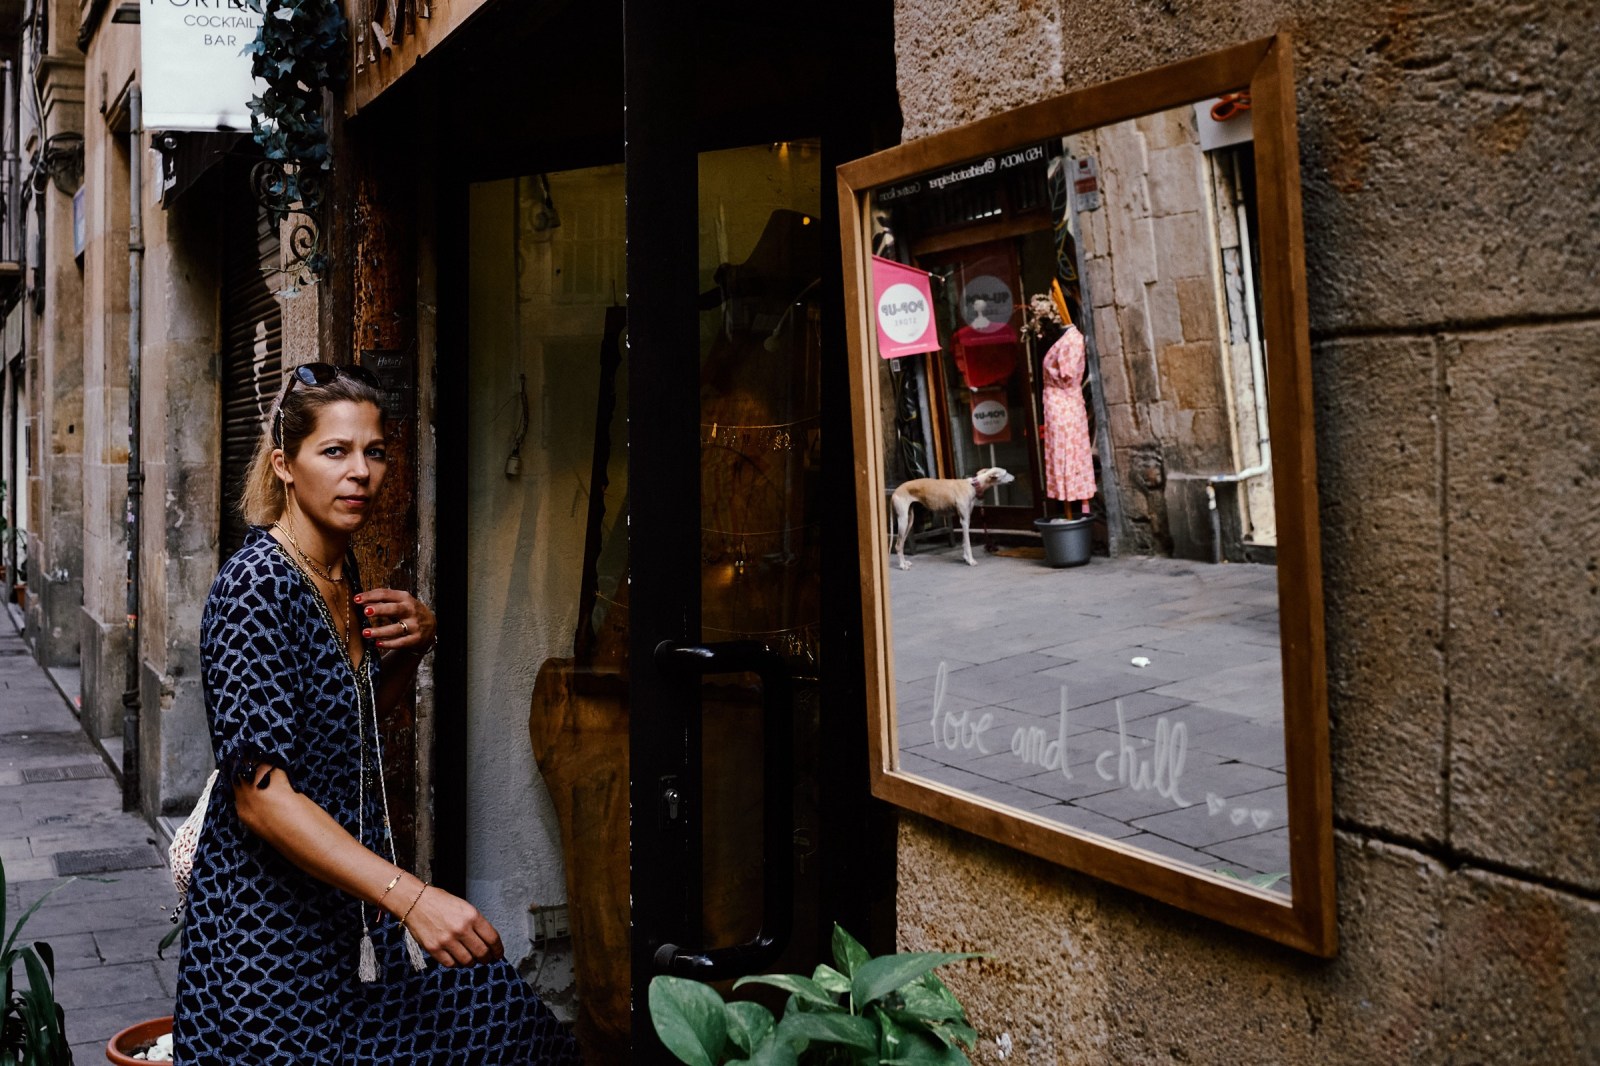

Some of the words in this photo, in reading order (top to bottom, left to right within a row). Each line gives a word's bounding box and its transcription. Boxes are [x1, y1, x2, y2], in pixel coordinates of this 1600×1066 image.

[184, 15, 255, 28] COCKTAIL
[204, 34, 237, 46] BAR
[930, 661, 993, 754] love
[1011, 685, 1074, 780] and
[1095, 699, 1192, 807] chill
